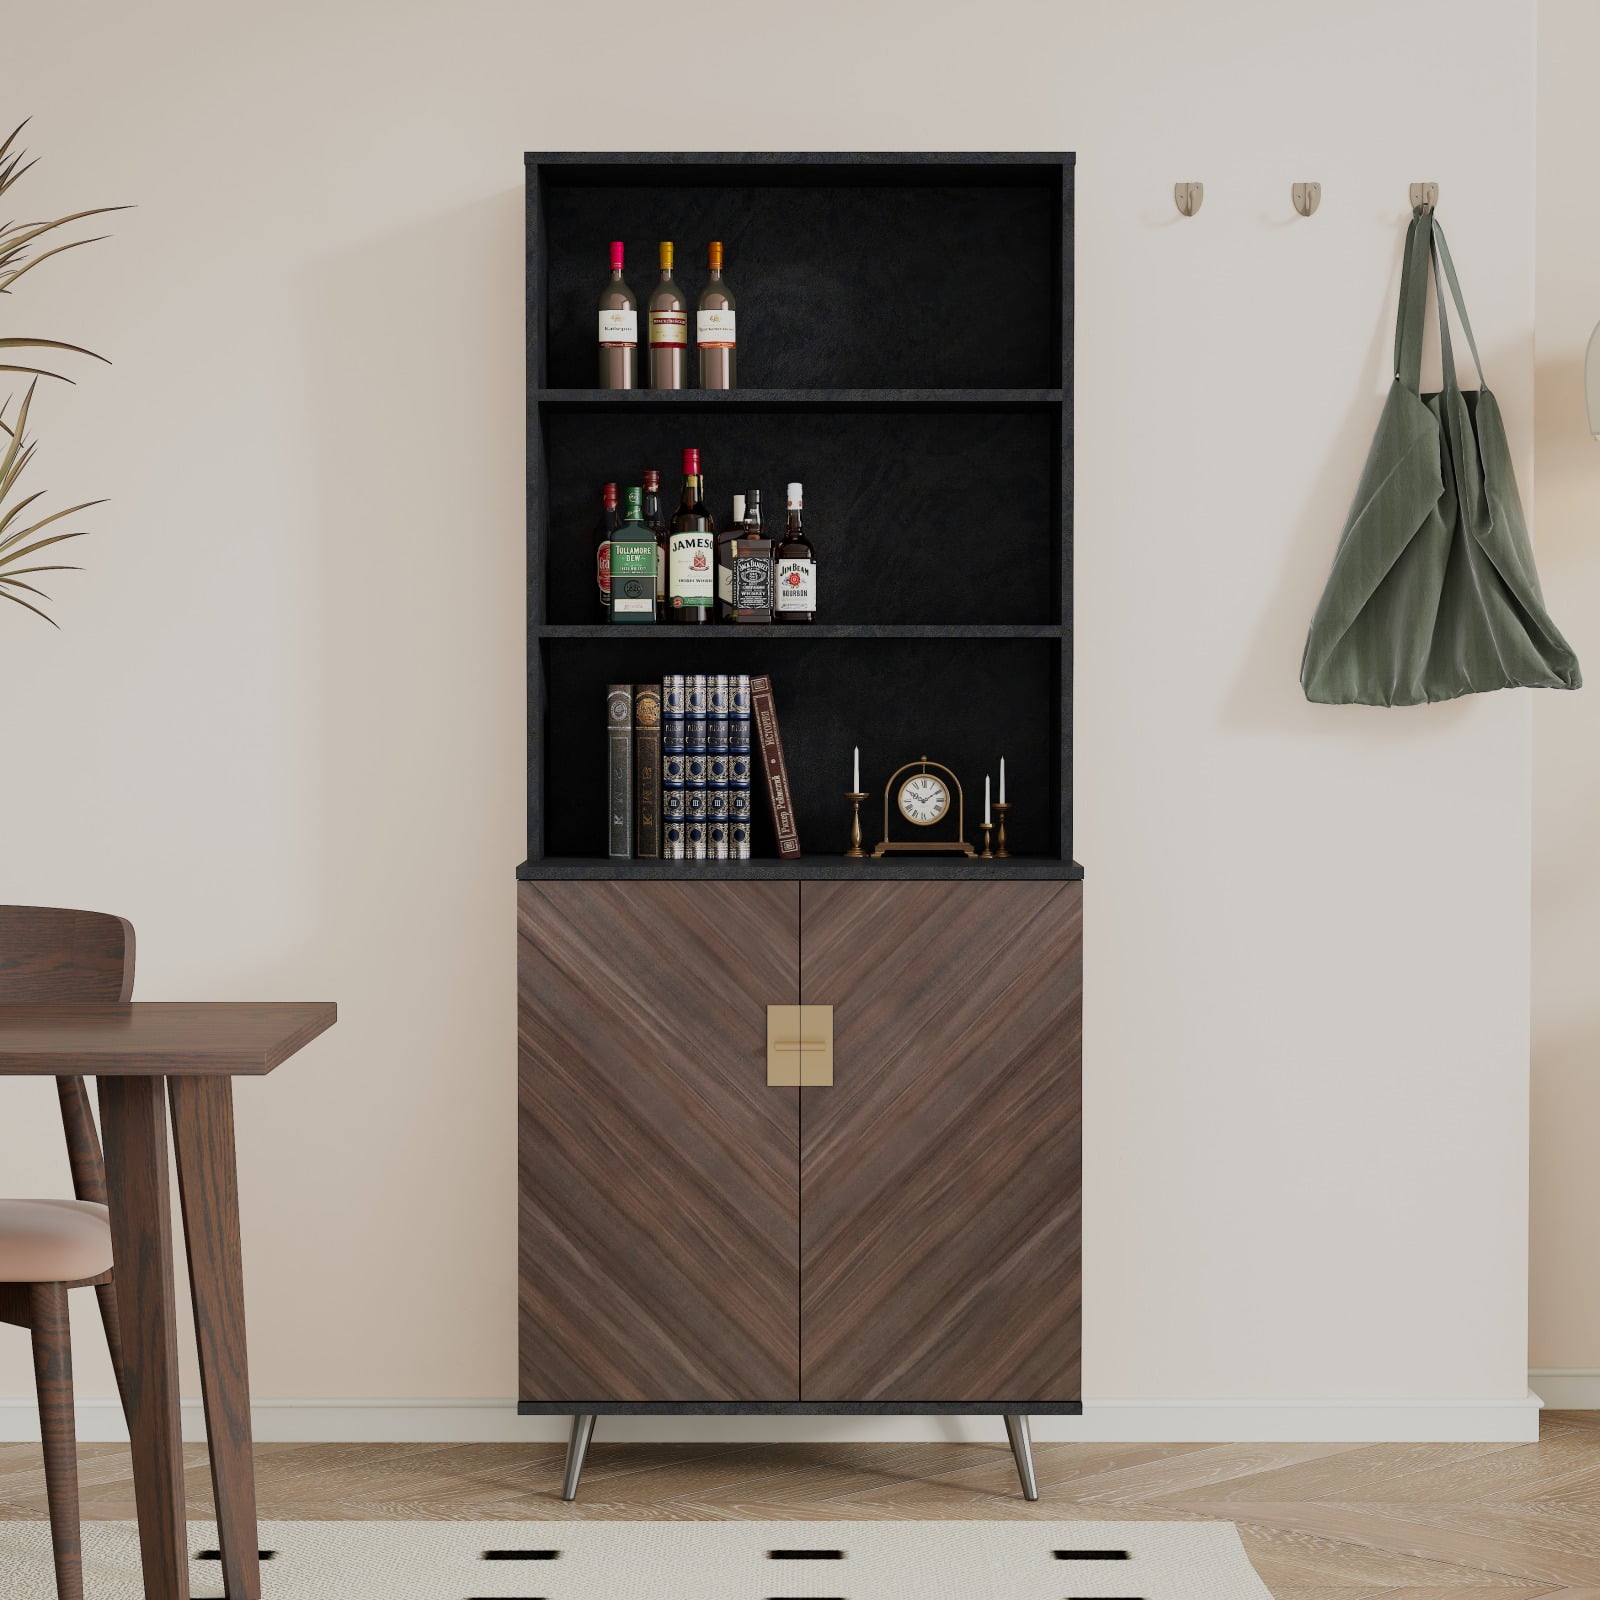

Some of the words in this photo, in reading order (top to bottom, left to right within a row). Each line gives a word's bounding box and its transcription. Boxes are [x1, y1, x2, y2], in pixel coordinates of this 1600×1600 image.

[615, 545, 652, 555] TULLAMORE
[780, 565, 792, 577] JIM
[792, 563, 809, 576] BEAM
